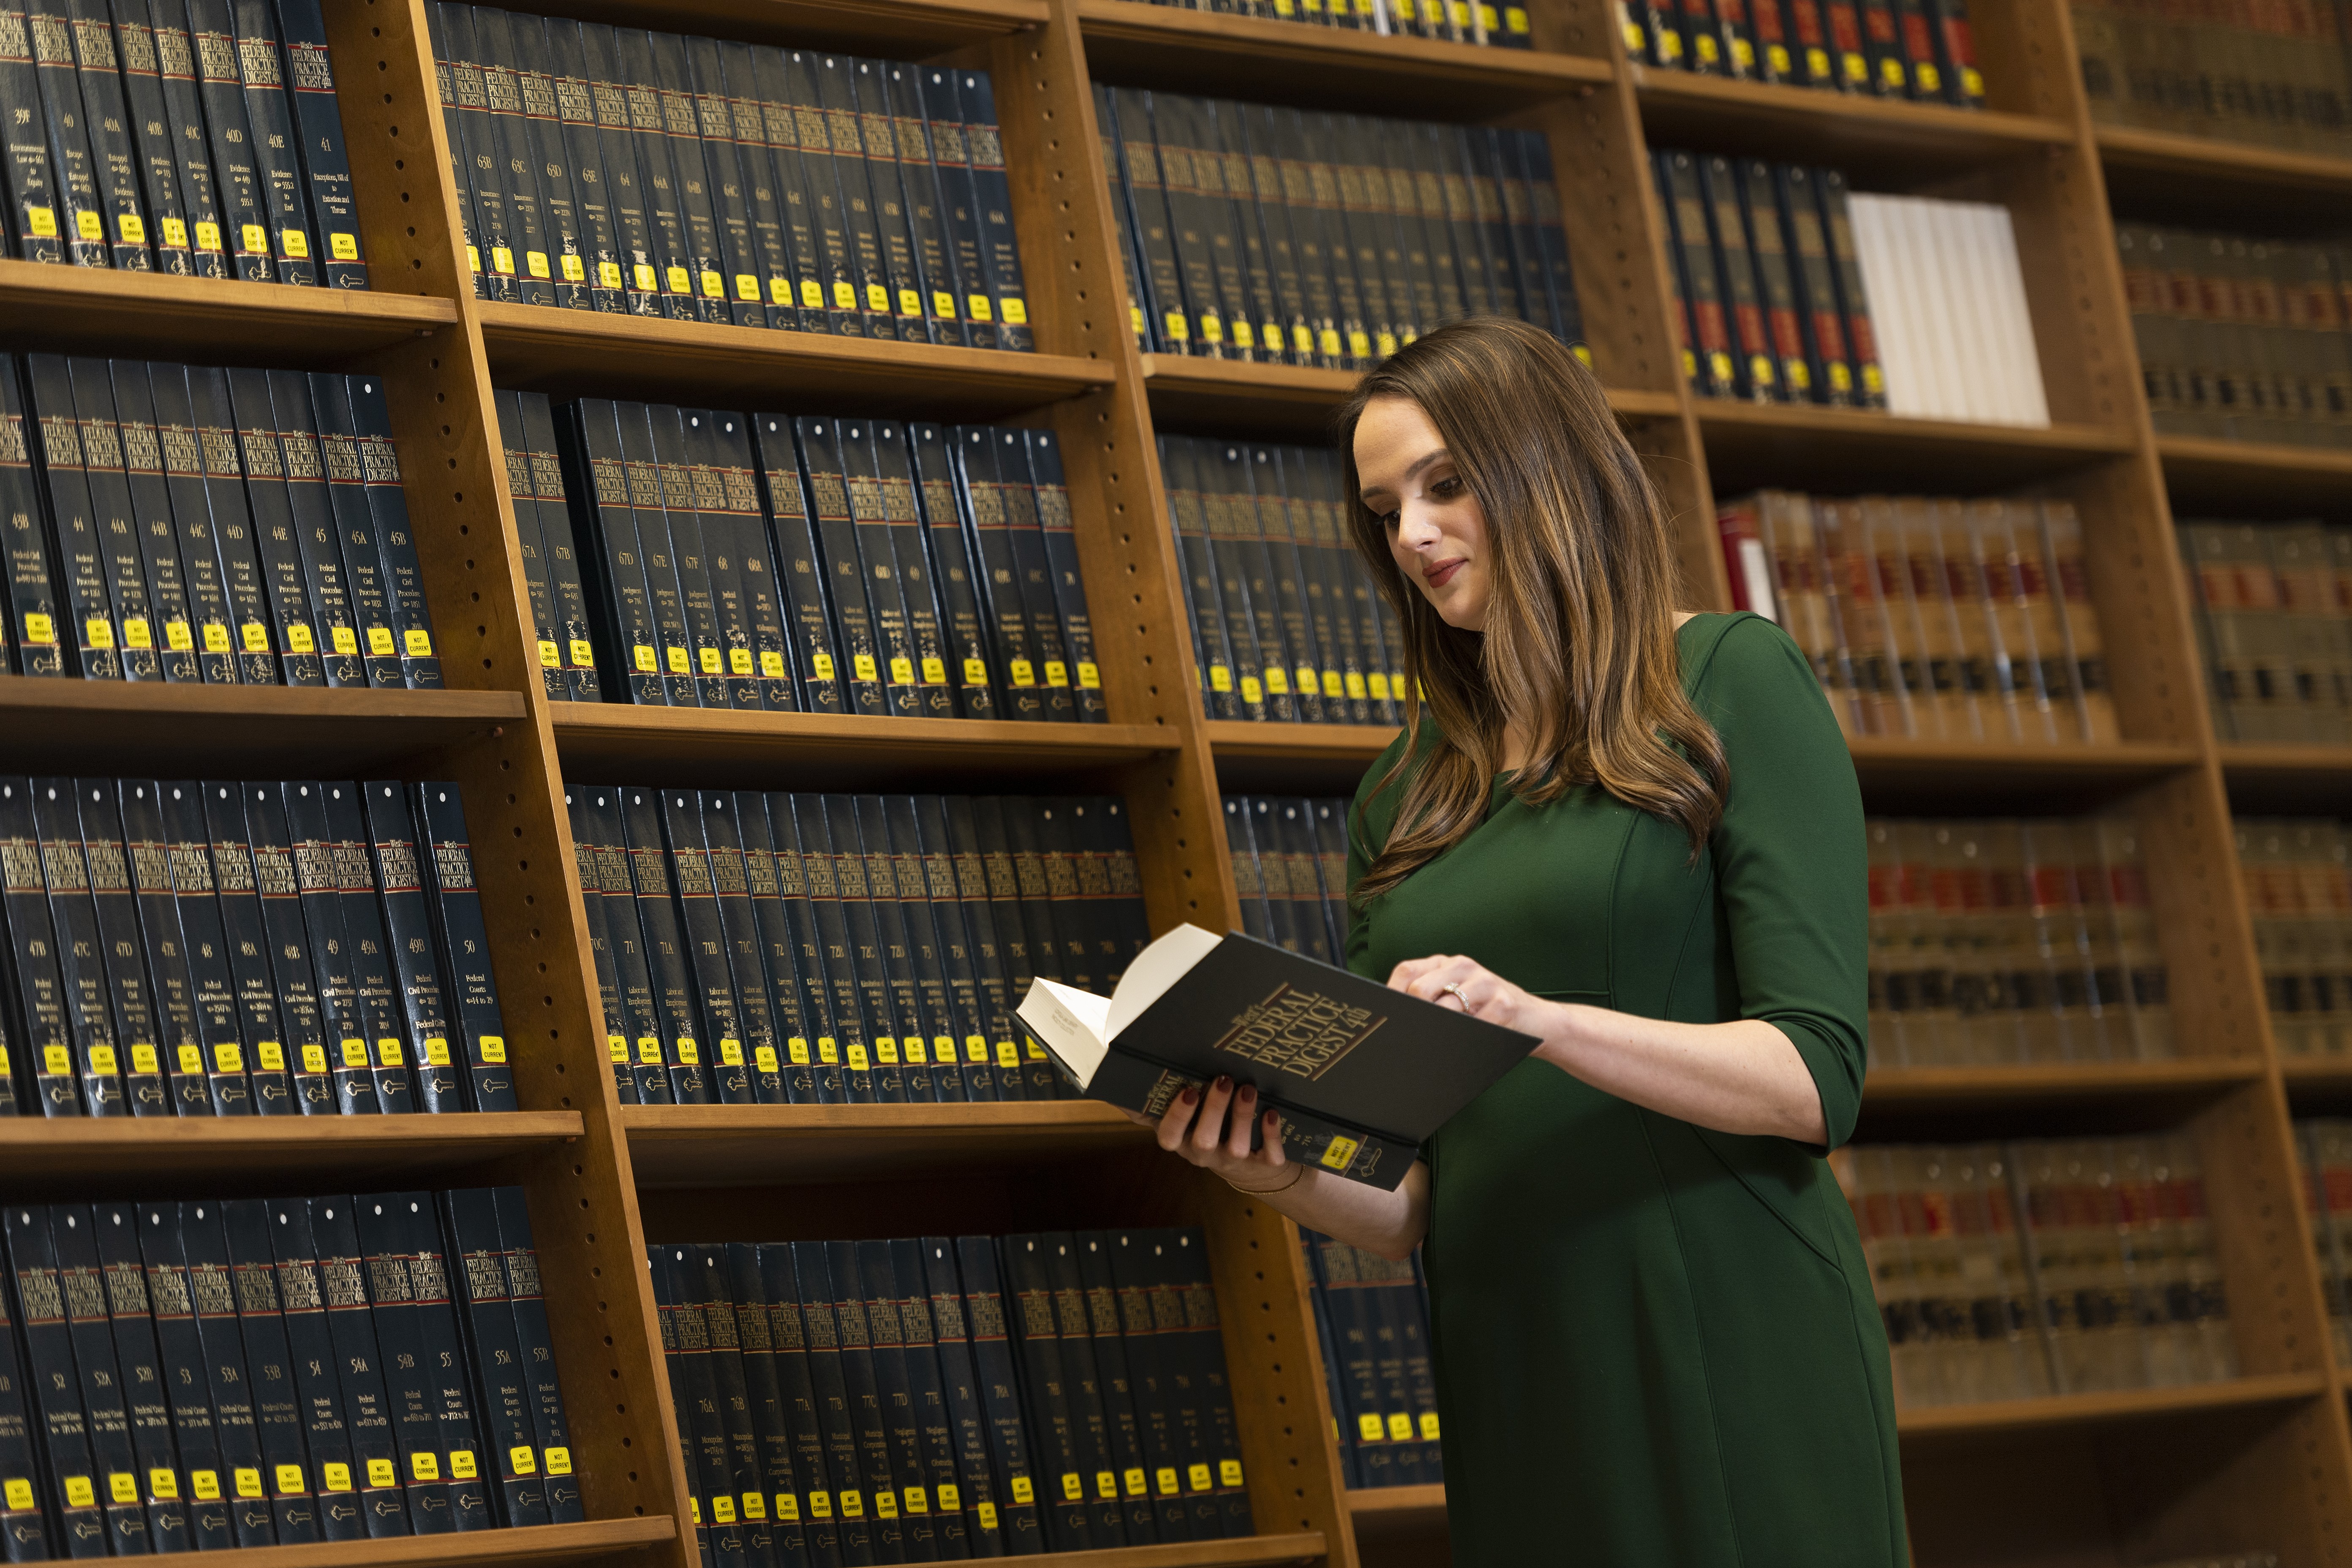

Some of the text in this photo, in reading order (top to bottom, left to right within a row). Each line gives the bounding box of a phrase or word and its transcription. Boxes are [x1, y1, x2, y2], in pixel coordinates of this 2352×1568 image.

[250, 37, 263, 45] West's
[300, 41, 313, 49] West's
[240, 45, 275, 58] FEDERAL
[291, 49, 326, 62] FEDERAL
[242, 58, 278, 71] PRACTICE
[294, 62, 329, 75] PRACTICE
[244, 70, 280, 84] DIGEST 4th
[296, 74, 331, 88] DIGEST 4th
[454, 68, 483, 81] FEDERAL
[455, 81, 485, 95] PRACTICE
[458, 93, 480, 106] DIGEST
[269, 133, 284, 148] 40E
[321, 137, 331, 151] 41
[477, 154, 492, 169] 63B
[512, 158, 525, 174] 63C
[271, 170, 292, 178] Evidence
[313, 174, 337, 182] Exceptions,
[282, 182, 294, 190] 555.2
[361, 443, 394, 456] FEDERAL
[363, 455, 397, 468] PRACTICE
[532, 458, 560, 471] FEDERAL
[366, 468, 392, 481] DIGEST
[534, 471, 563, 485] PRACTICE
[594, 465, 623, 478] FEDERAL
[536, 483, 558, 497] DIGEST
[596, 477, 626, 490] PRACTICE
[599, 489, 621, 503] DIGEST
[391, 531, 406, 546] 45B
[556, 545, 570, 559] 67B
[619, 551, 633, 565] 67D
[719, 556, 728, 570] 68
[560, 581, 578, 590] Judgment
[623, 587, 642, 595] Judgment
[444, 841, 457, 849] West's
[436, 849, 467, 861] FEDERAL
[596, 853, 626, 865] FEDERAL
[438, 862, 470, 874] PRACTICE
[599, 866, 629, 878] PRACTICE
[441, 874, 473, 888] DIGEST 4th
[601, 879, 624, 891] DIGEST
[464, 940, 475, 954] 50
[624, 941, 634, 954] 71
[466, 974, 485, 982] Federal
[628, 998, 652, 1006] Employment
[1231, 1002, 1265, 1026] West's
[1225, 990, 1320, 1059] FEDERAL
[1253, 997, 1348, 1069] PRACTICE
[1282, 1007, 1372, 1078] DIGEST 4th
[1285, 1124, 1295, 1135] 682
[1302, 1135, 1312, 1146] 715
[1331, 1146, 1341, 1157] NOT
[1335, 1142, 1352, 1166] CURRENT
[476, 1250, 488, 1258] West's
[466, 1257, 500, 1272] FEDERAL
[469, 1270, 503, 1285] PRACTICE
[472, 1282, 506, 1299] DIGEST 4th
[675, 1310, 704, 1323] FEDERAL
[678, 1323, 707, 1335] PRACTICE
[680, 1336, 701, 1349] DIGEST
[495, 1350, 512, 1365] 55A
[501, 1386, 518, 1395] Federal
[505, 1397, 519, 1405] Courts
[699, 1398, 714, 1413] 76A
[795, 1399, 810, 1411] 77A
[702, 1436, 723, 1445] Monopolies
[515, 1460, 533, 1469] CURRENT
